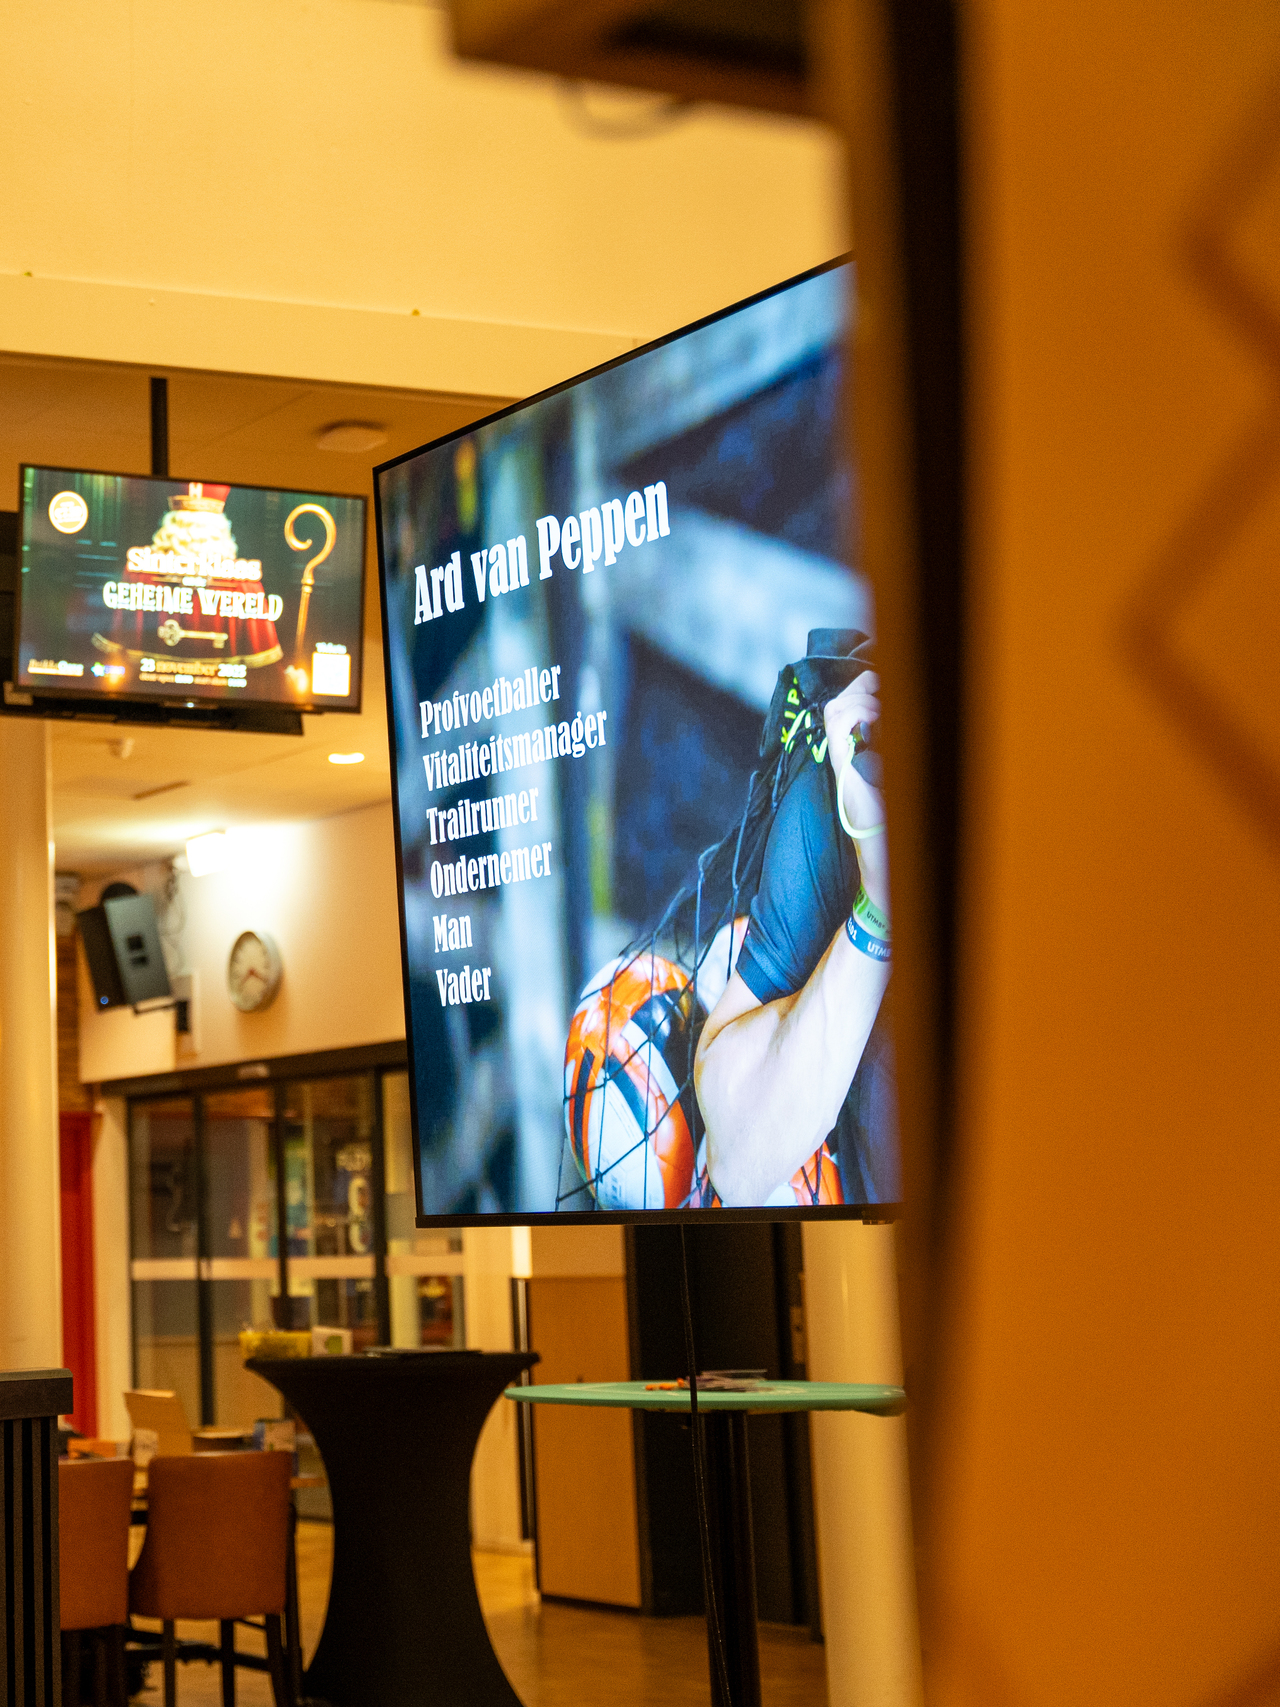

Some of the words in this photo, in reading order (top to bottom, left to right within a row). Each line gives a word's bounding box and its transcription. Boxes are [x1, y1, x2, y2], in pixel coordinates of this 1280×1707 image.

[414, 551, 465, 626] Ard
[470, 535, 530, 603] van
[535, 480, 671, 580] Peppen
[103, 581, 194, 615] GEHEIME
[197, 587, 284, 622] WERELD
[420, 664, 561, 739] Profvoetballer
[423, 710, 607, 791] Vitaliteitsmanager
[426, 787, 538, 846] Trailrunner
[431, 842, 552, 898] Ondernemer
[433, 914, 473, 953] Man
[436, 965, 491, 1007] Vader
